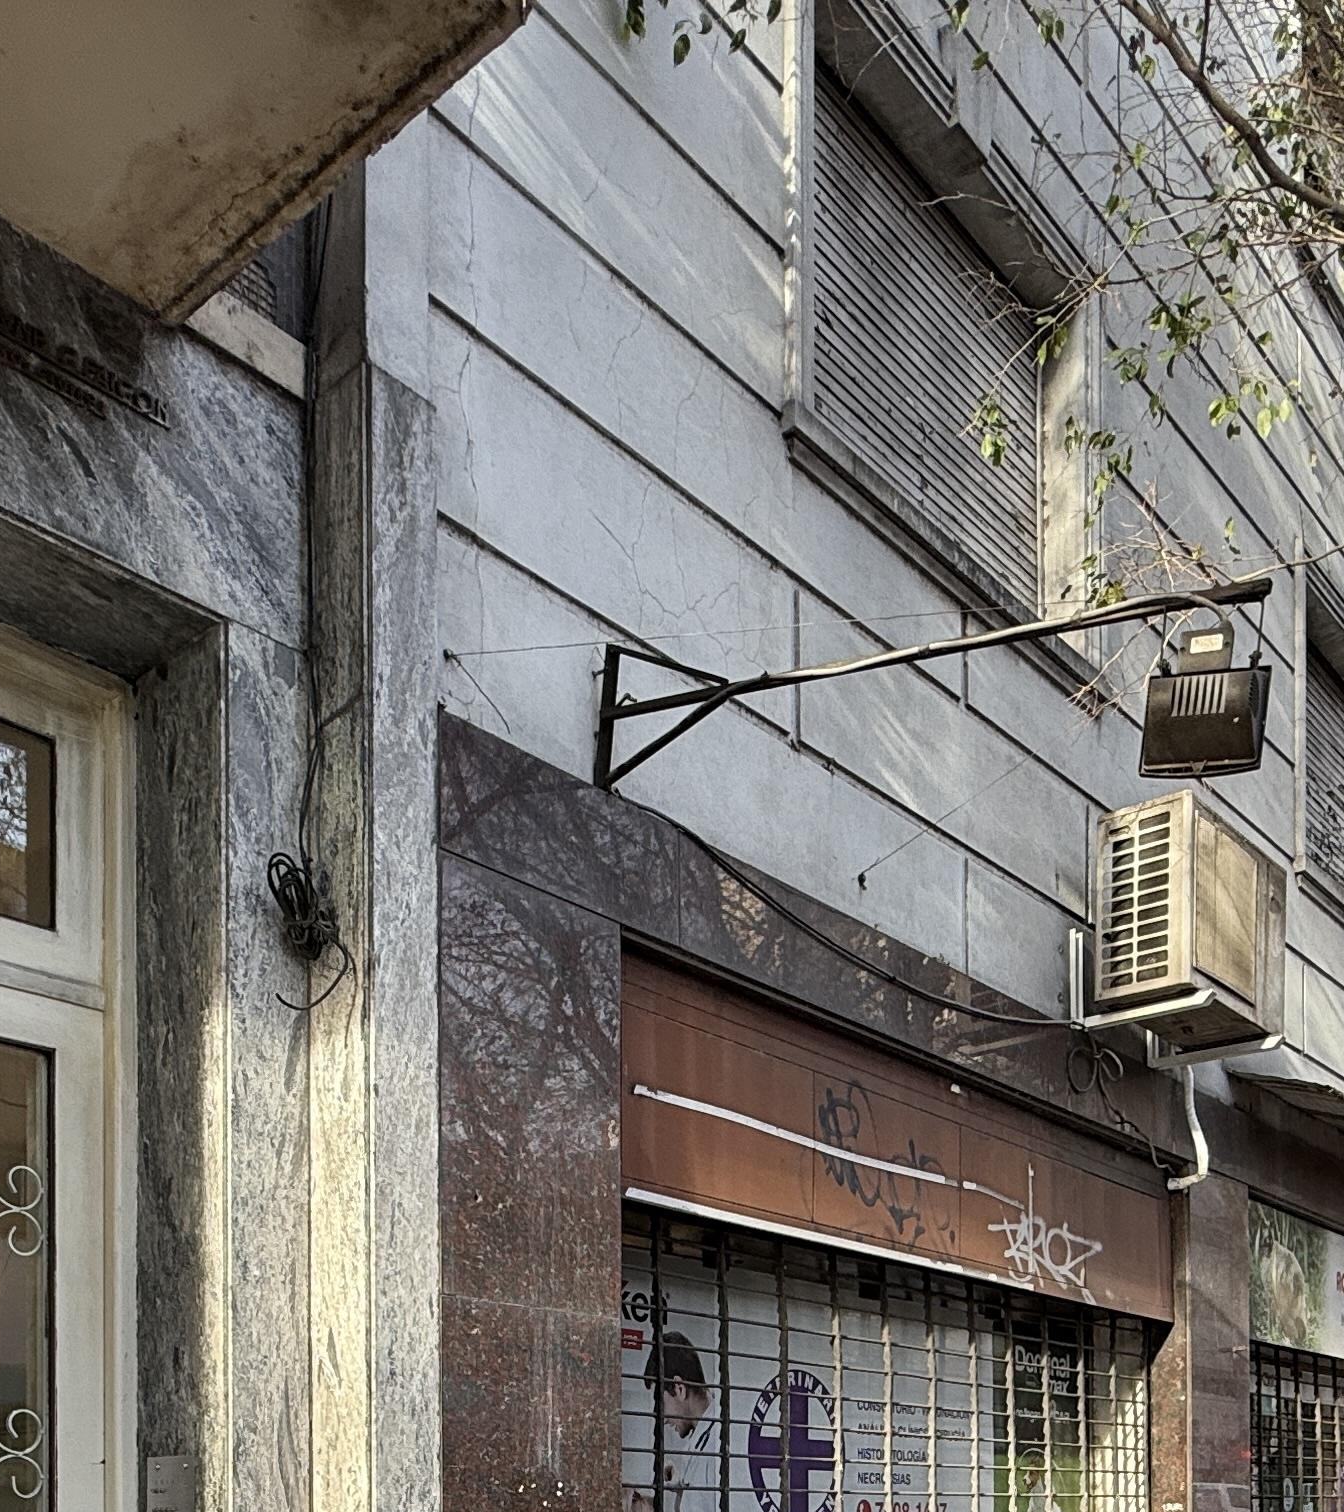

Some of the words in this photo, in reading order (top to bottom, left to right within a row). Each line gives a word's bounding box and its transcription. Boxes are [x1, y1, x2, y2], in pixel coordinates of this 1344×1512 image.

[751, 1371, 837, 1426] VETRINAR
[857, 1447, 928, 1463] HISTOTOLOGÍA
[857, 1471, 911, 1486] NECROSIAS
